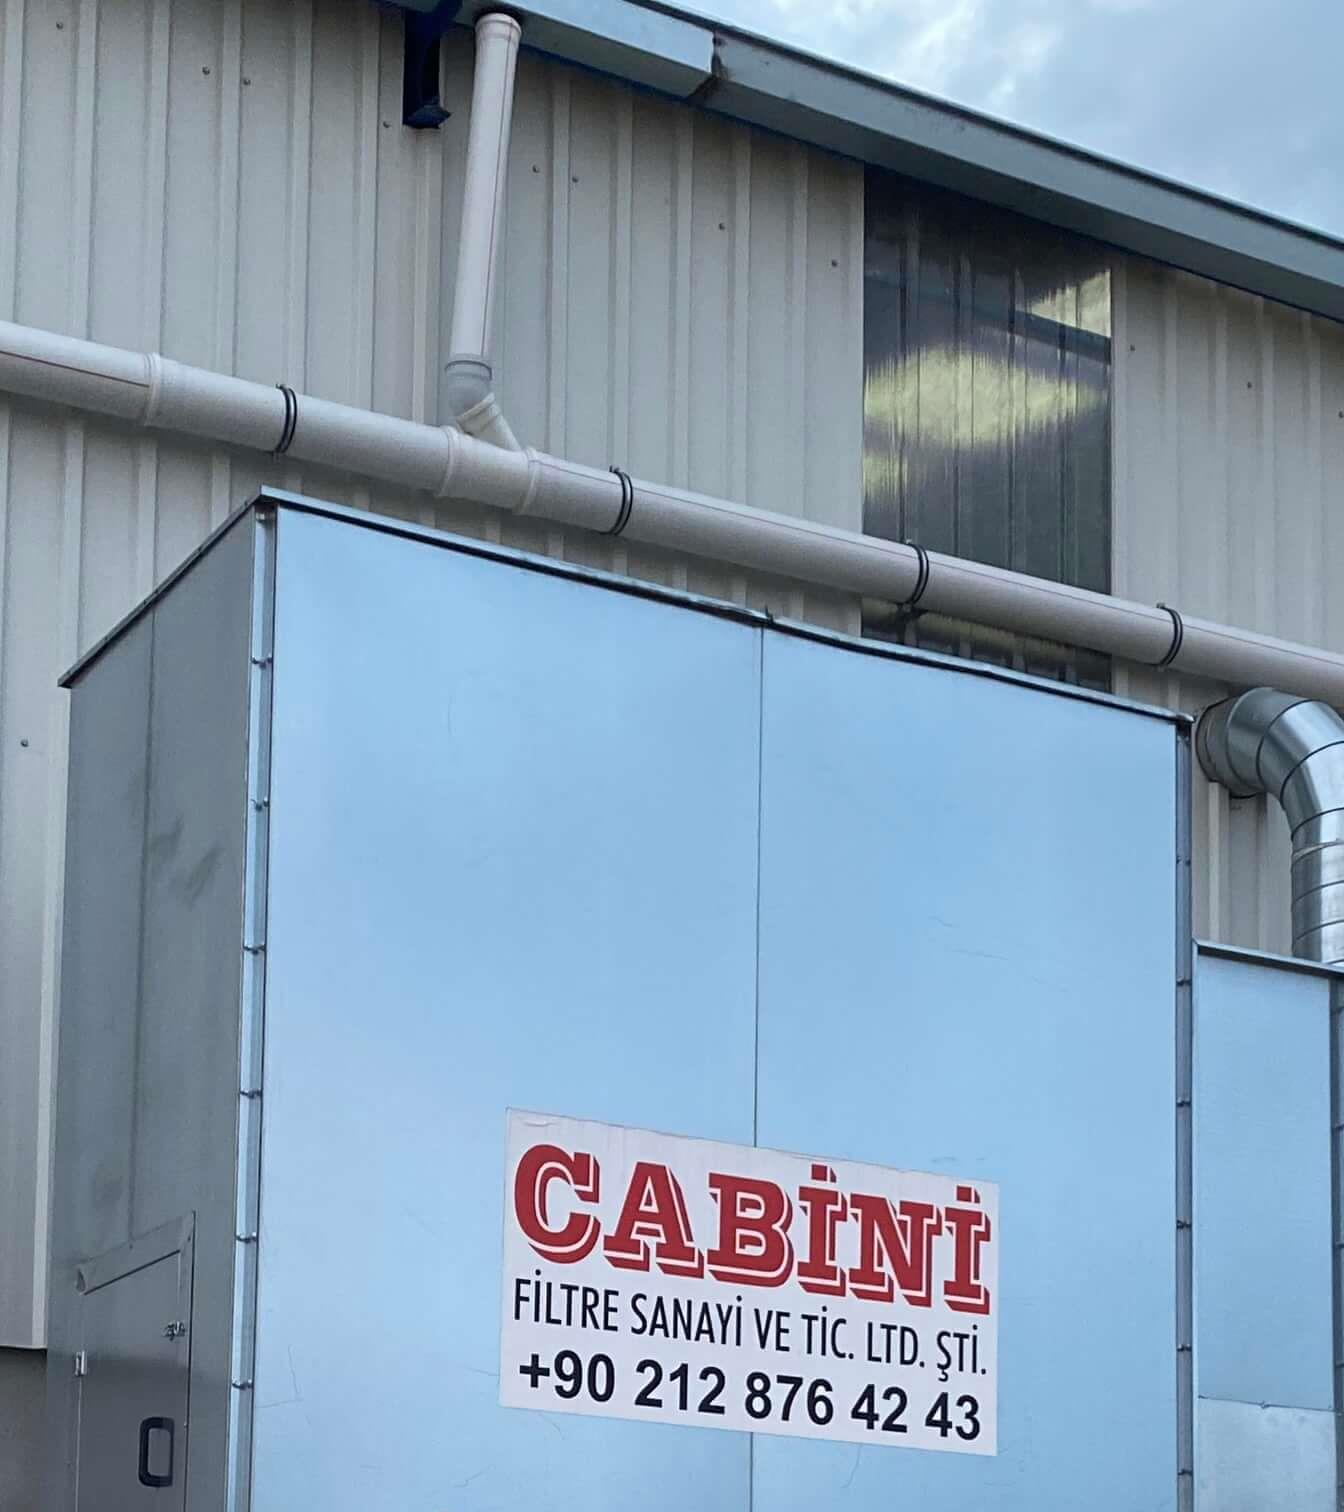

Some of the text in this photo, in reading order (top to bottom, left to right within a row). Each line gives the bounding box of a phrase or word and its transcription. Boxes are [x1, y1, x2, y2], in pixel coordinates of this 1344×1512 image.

[514, 1144, 991, 1315] CABİNİ
[514, 1269, 986, 1381] FİLTRE SANAYİ VE TİC. LTD. ŞTİ.
[519, 1350, 980, 1440] +90 212 876 42 43
